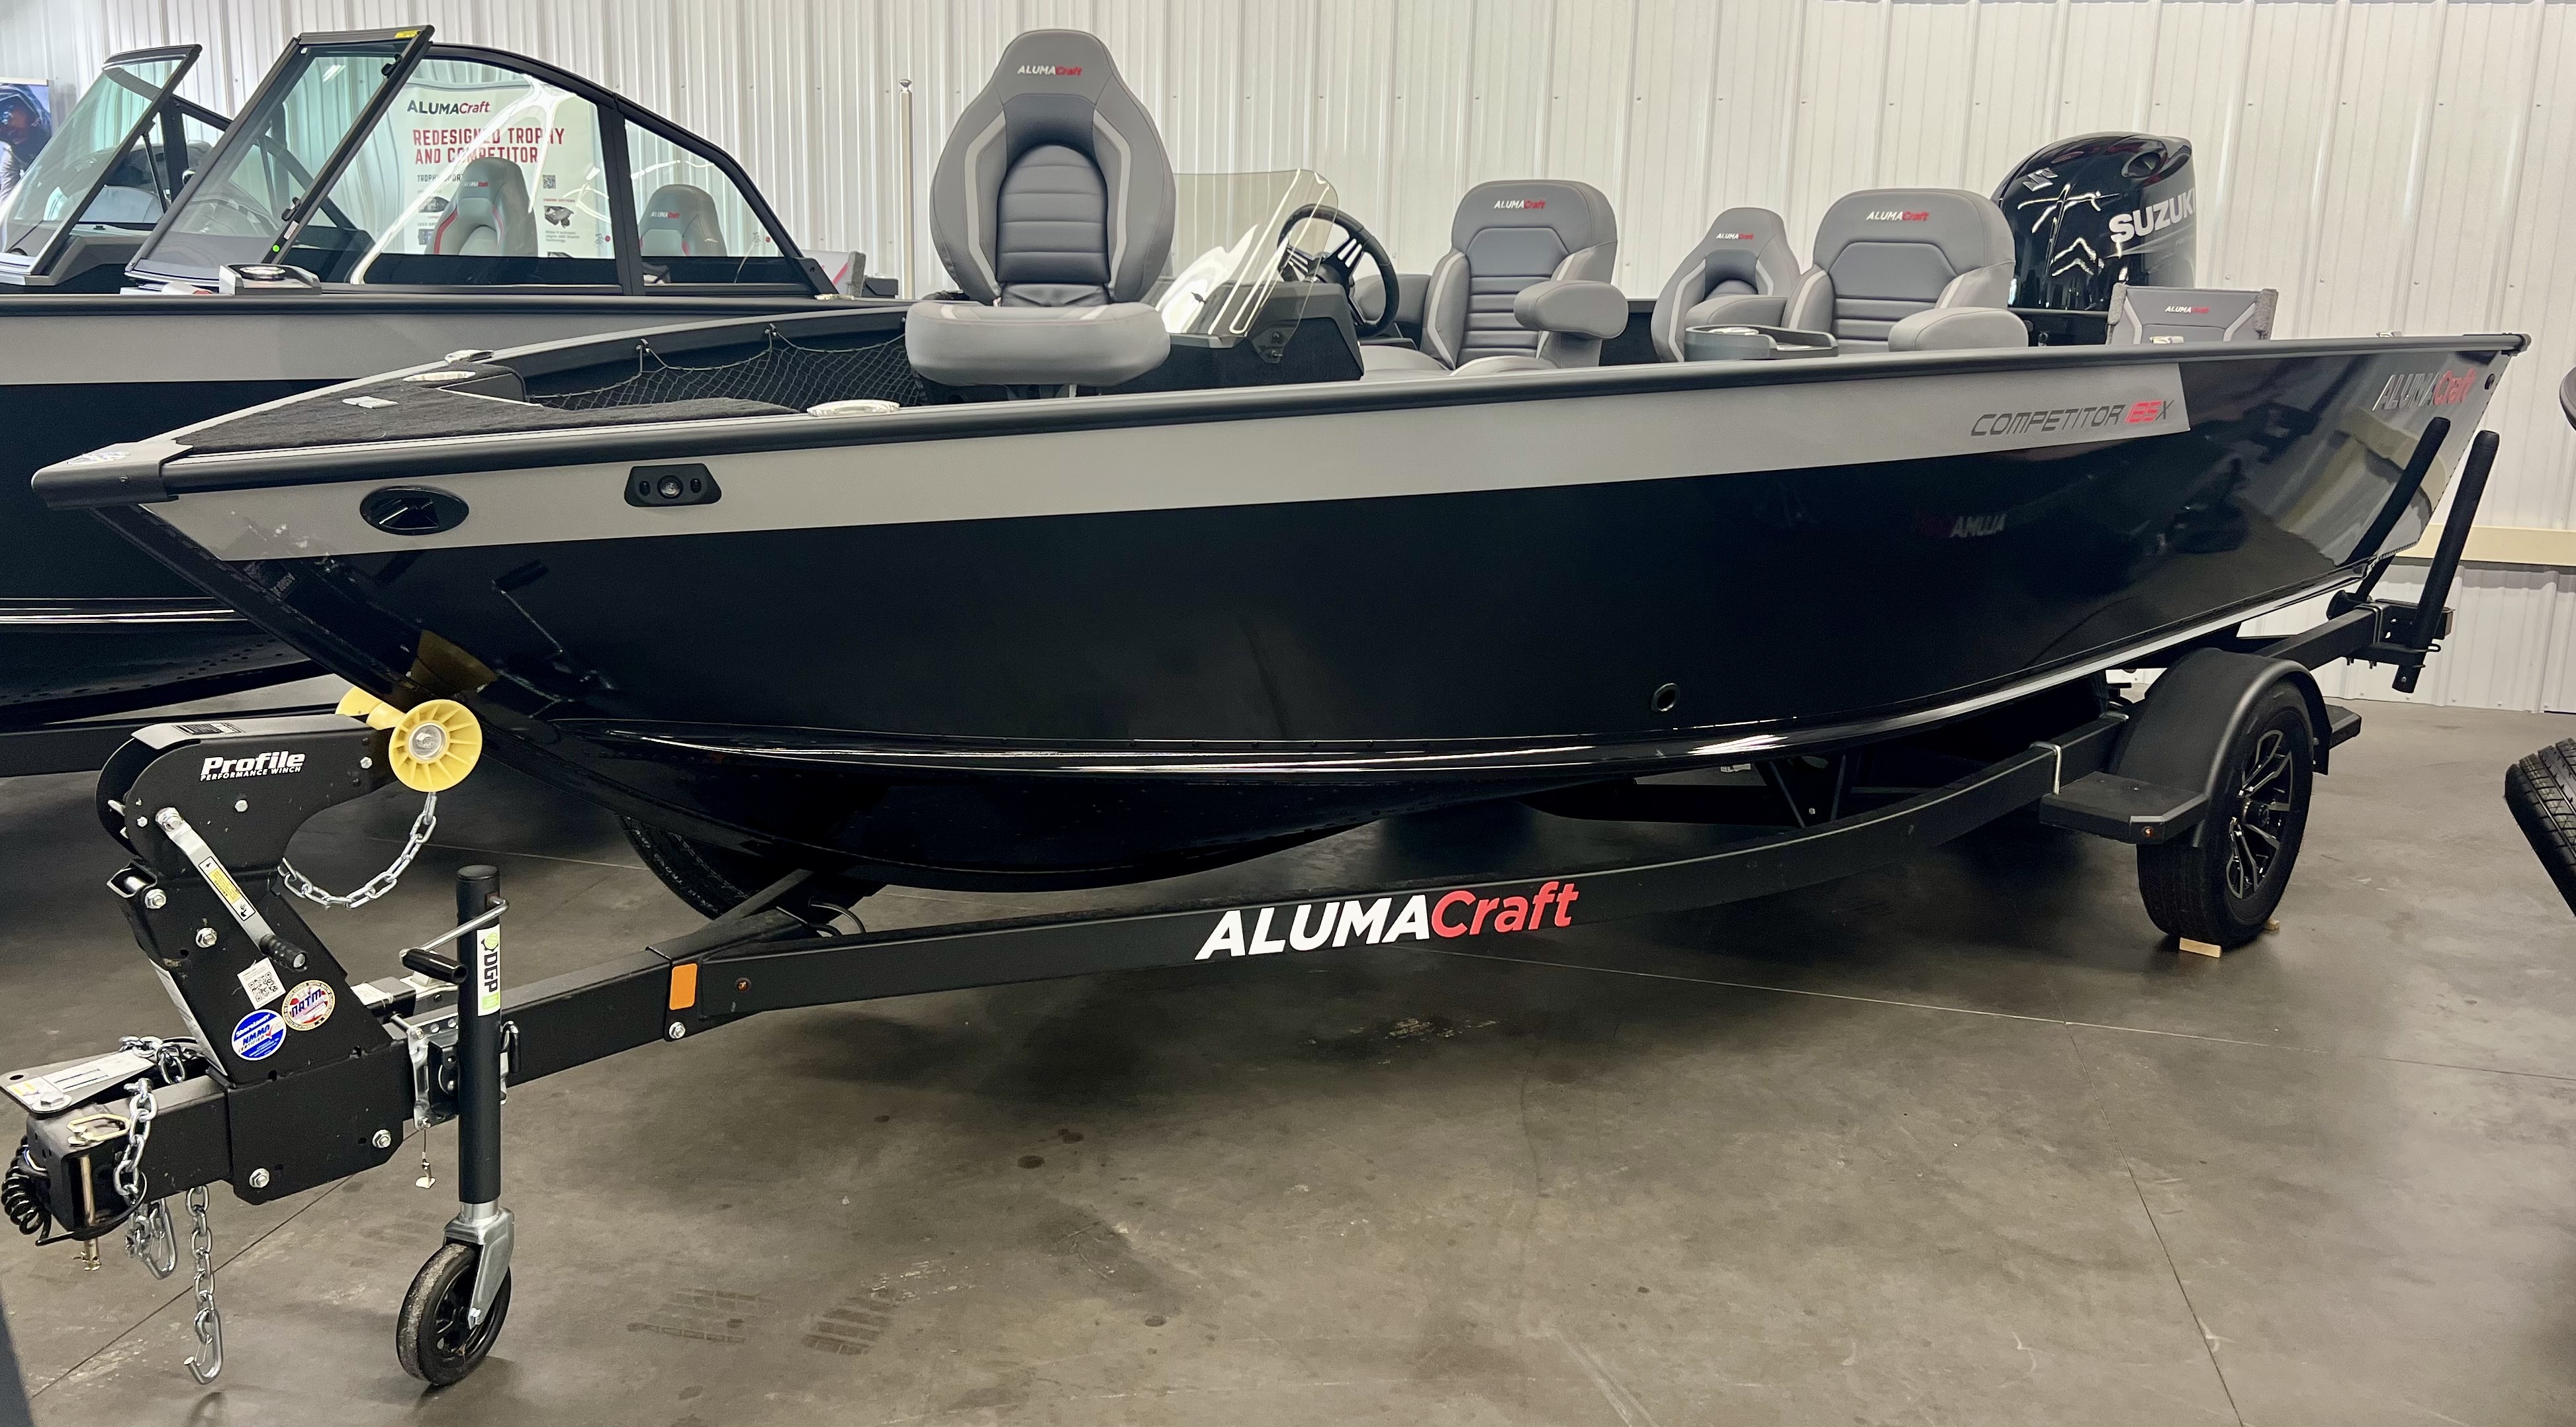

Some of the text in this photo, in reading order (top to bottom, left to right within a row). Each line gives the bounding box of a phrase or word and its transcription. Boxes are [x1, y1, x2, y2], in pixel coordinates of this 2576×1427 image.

[406, 100, 490, 115] ALUMACraft
[413, 128, 500, 146] REDESIGND
[415, 148, 441, 164] AND
[2109, 187, 2196, 243] SUZUKI
[1970, 404, 2127, 437] COMPETITOR
[200, 751, 306, 776] Profile
[200, 766, 301, 782] PERFORMANCE WINCH
[1194, 881, 1579, 960] ALUMACraft
[484, 951, 498, 993] DGP
